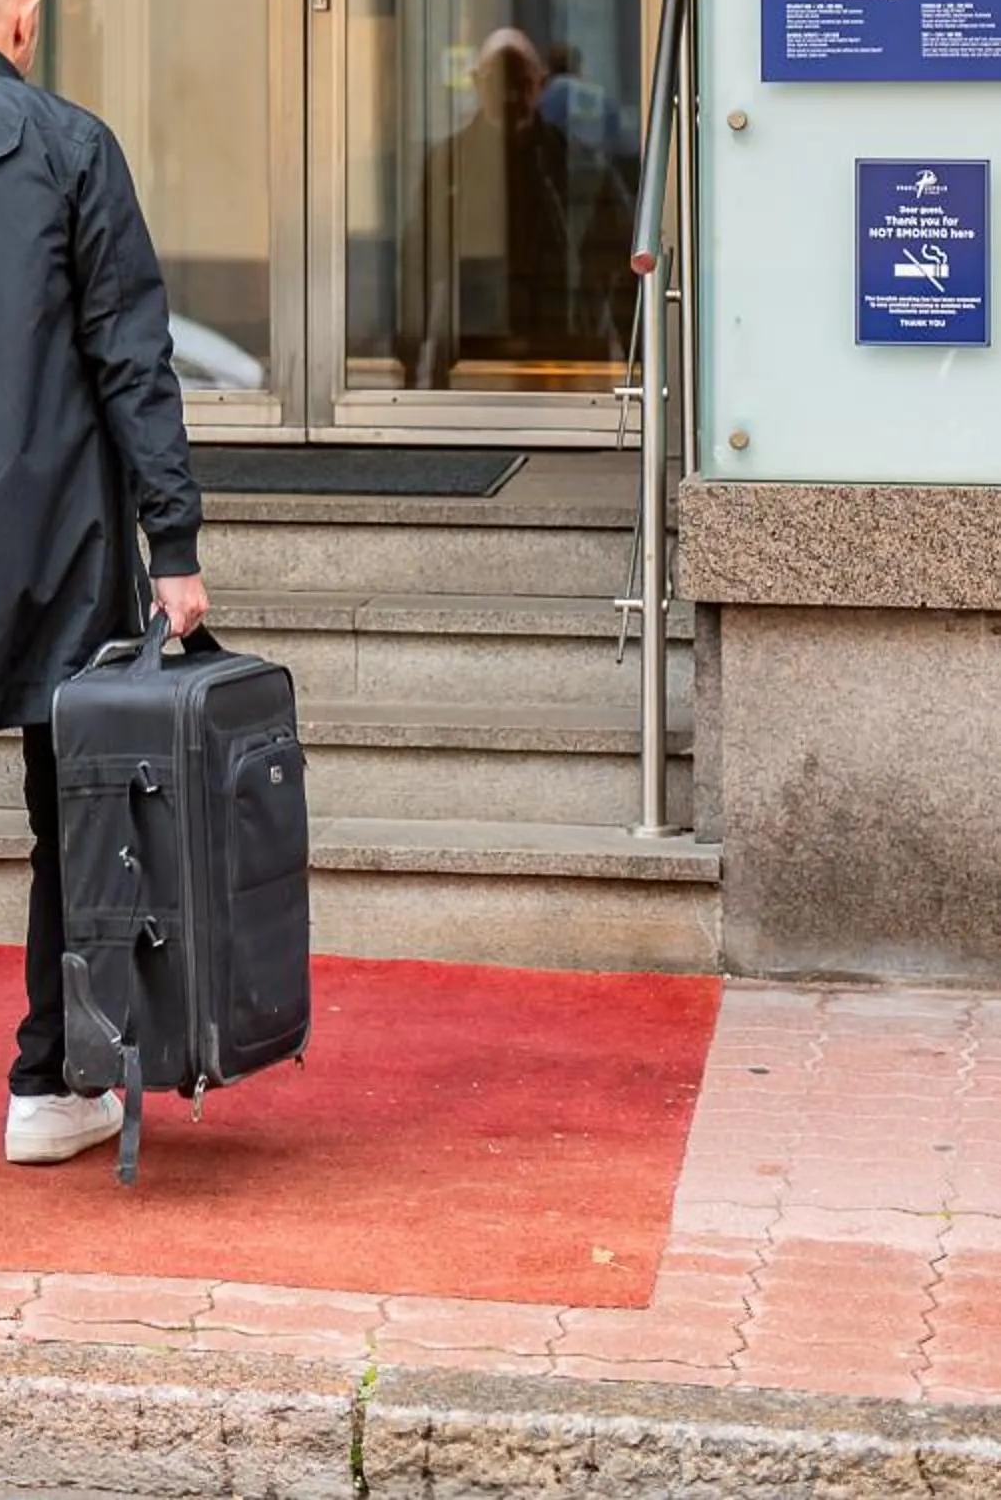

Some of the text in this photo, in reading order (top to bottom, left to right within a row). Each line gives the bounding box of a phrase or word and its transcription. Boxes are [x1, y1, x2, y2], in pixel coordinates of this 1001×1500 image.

[885, 215, 959, 227] Thank you for
[869, 227, 975, 239] NOT SMOKING here
[929, 319, 945, 327] YOU
